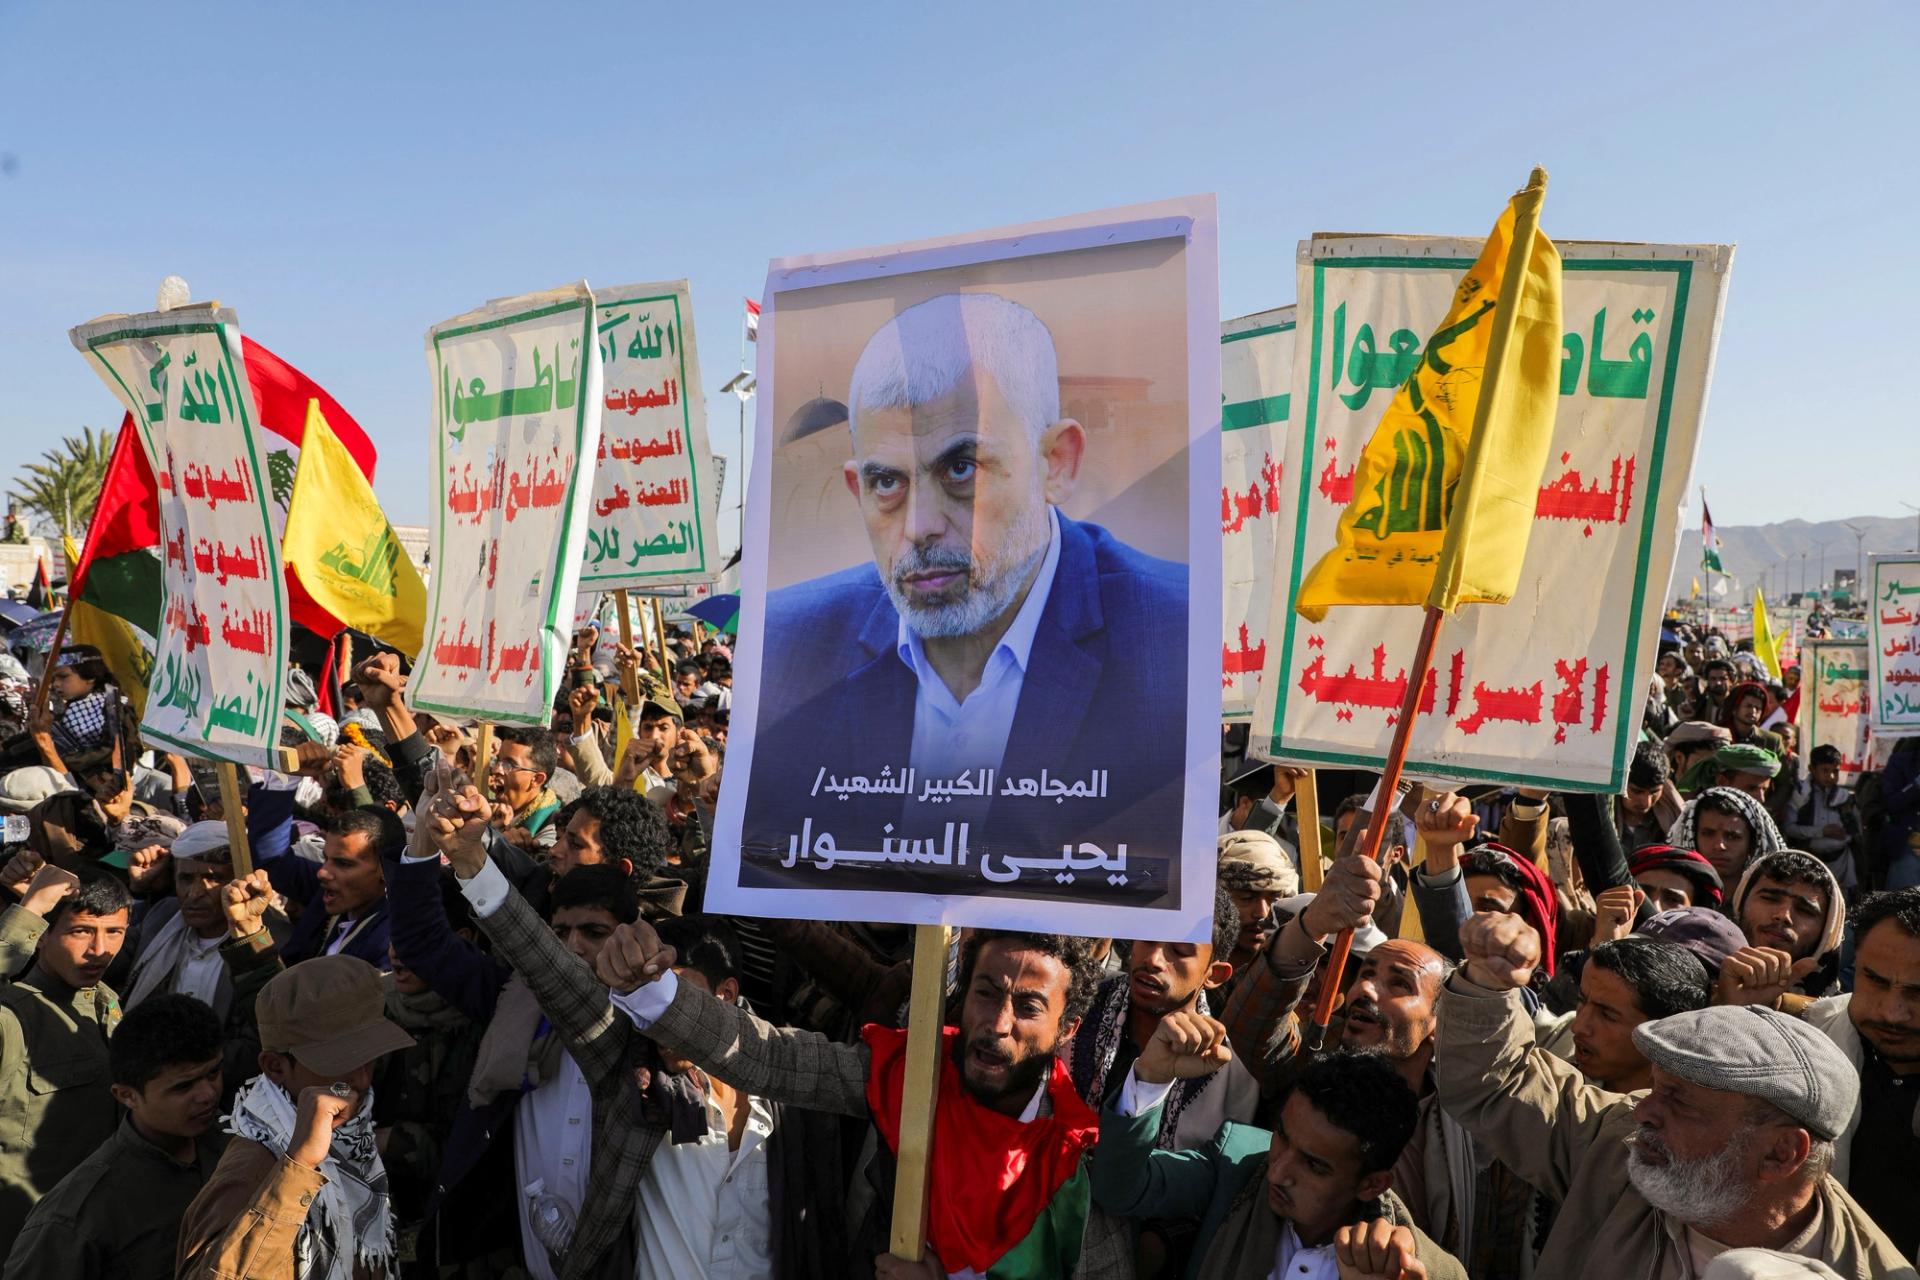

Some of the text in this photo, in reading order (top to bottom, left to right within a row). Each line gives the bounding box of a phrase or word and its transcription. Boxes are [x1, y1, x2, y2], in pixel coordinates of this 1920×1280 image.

[606, 378, 677, 416] الموت
[611, 428, 683, 465] الموت
[184, 456, 254, 511] الموت
[596, 476, 689, 517] اللعنة على
[1534, 451, 1636, 538] البض
[194, 533, 267, 586] الموت
[625, 520, 694, 568] النصر
[222, 600, 272, 656] اللعنة
[203, 669, 271, 741] النصر
[919, 768, 994, 803] الكبير
[1001, 769, 1108, 804] المجاهد
[780, 818, 1128, 886] يحيى السنوار
